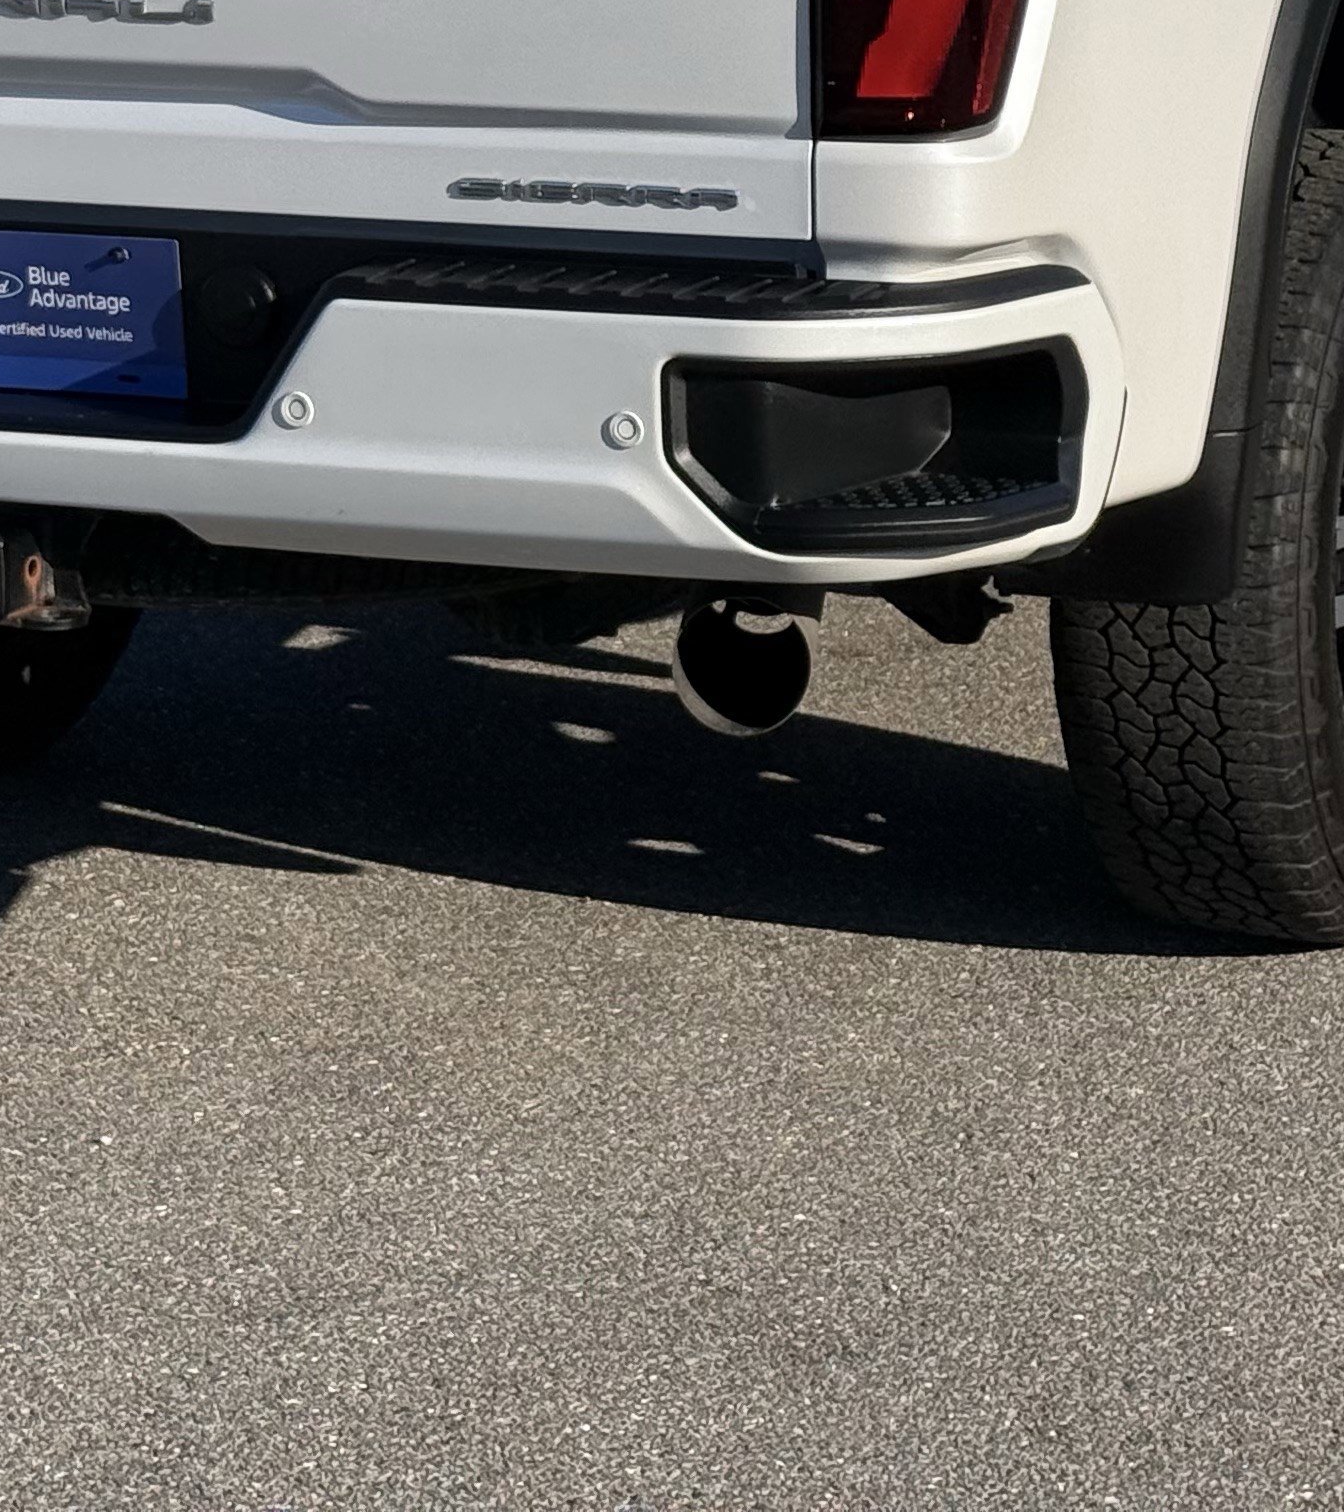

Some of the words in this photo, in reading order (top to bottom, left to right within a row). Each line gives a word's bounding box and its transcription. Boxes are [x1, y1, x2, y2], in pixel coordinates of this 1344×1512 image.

[446, 176, 740, 212] SIERRA
[27, 265, 71, 287] Blue
[29, 288, 131, 316] Advantage
[49, 324, 83, 340] Used
[85, 326, 134, 343] Vehicle
